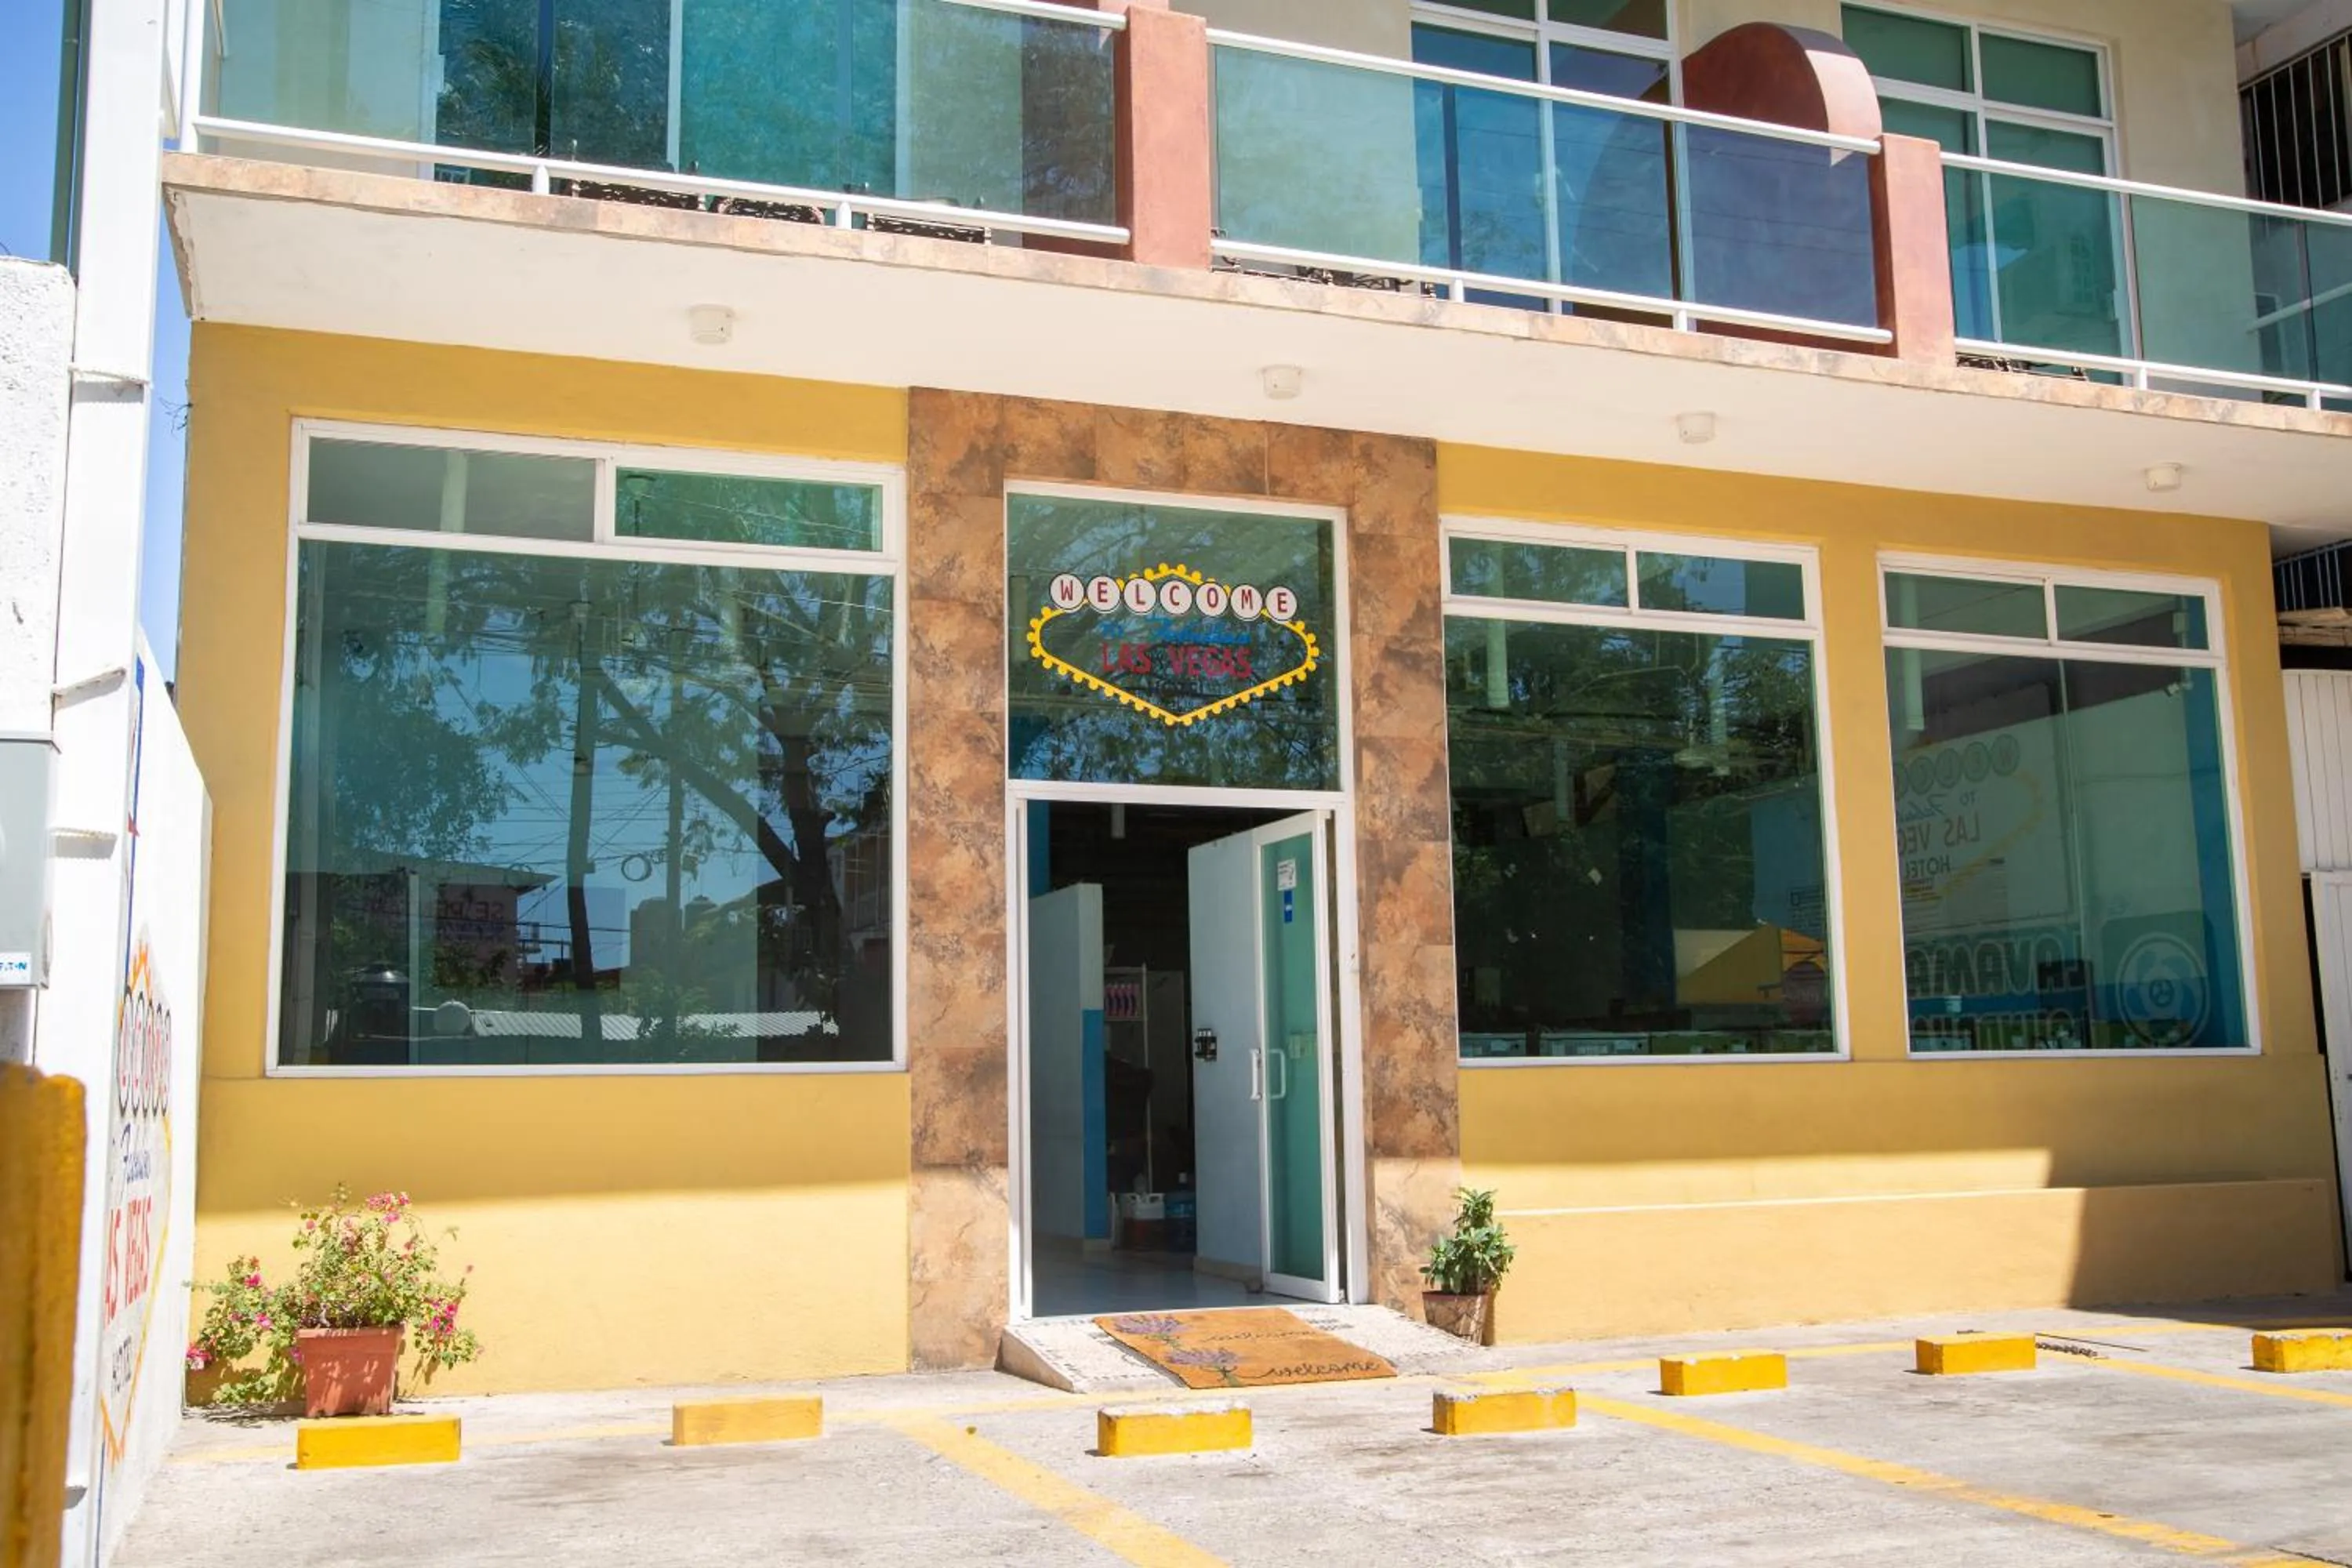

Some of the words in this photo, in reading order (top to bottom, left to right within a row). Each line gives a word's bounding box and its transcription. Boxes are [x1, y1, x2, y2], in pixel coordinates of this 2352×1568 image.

[1057, 577, 1292, 616] WELCOME
[1102, 643, 1152, 673] LAS
[1166, 645, 1252, 679] VEGAS
[105, 1208, 122, 1326] AS
[125, 1199, 151, 1306] VEGAS
[1259, 1361, 1381, 1377] welcome
